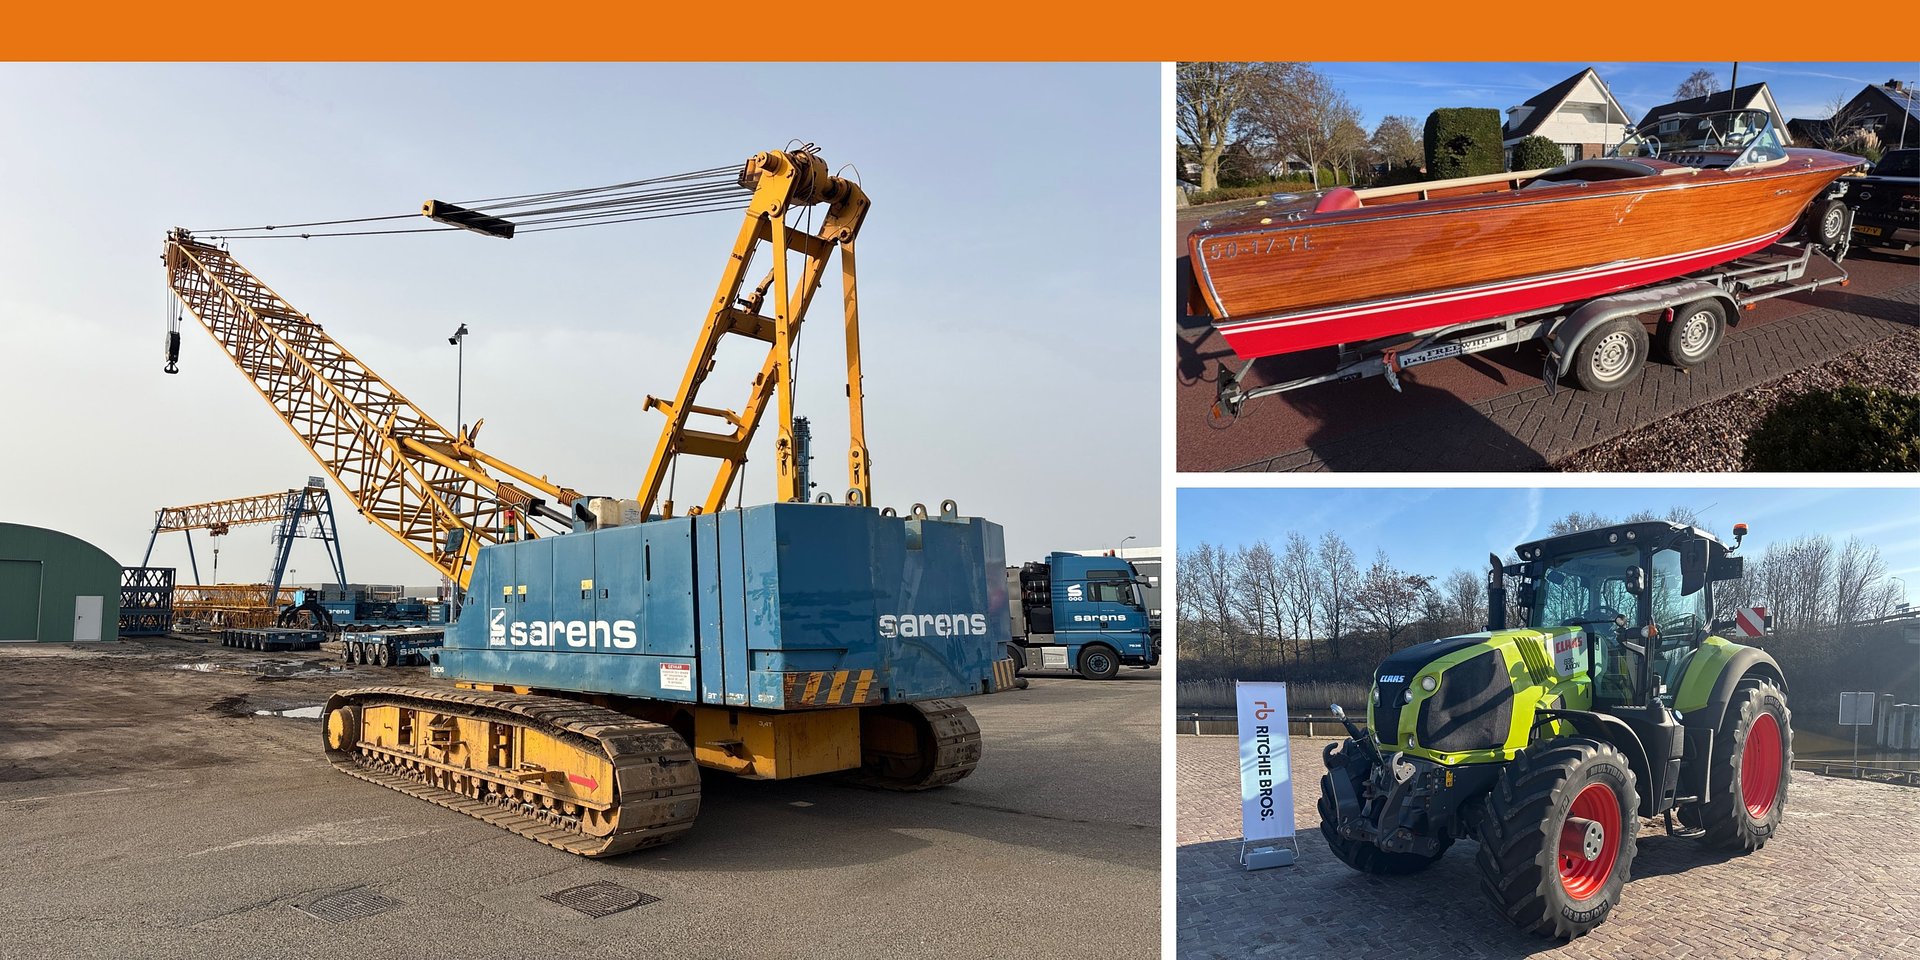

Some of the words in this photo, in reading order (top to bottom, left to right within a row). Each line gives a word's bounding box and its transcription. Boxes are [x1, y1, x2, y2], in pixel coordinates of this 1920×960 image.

[879, 613, 987, 638] sarens
[1073, 614, 1127, 622] sarens
[510, 619, 637, 649] sarens
[1555, 636, 1583, 654] CLAAS
[1379, 675, 1406, 683] CLAAS
[1255, 725, 1272, 776] RITCHIE
[1259, 779, 1274, 822] BROS.
[1580, 901, 1608, 923] 540/65
